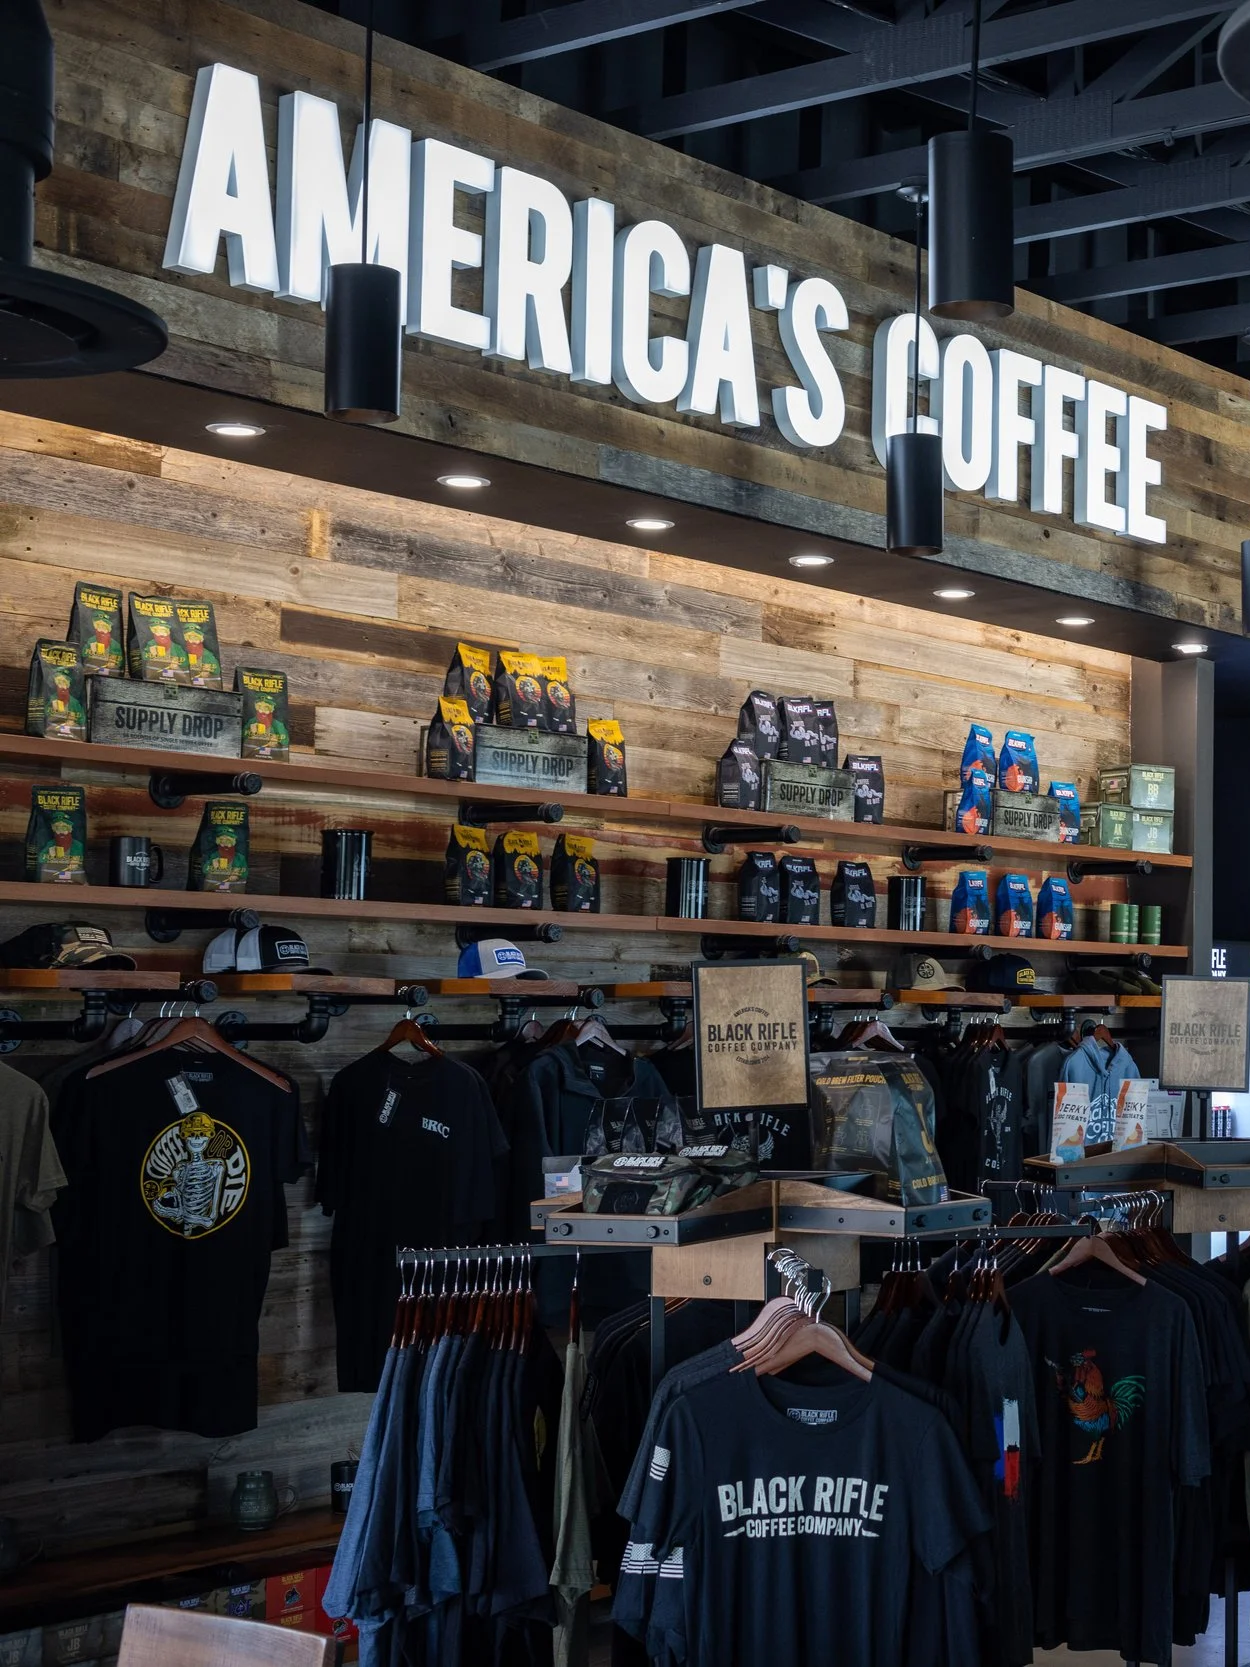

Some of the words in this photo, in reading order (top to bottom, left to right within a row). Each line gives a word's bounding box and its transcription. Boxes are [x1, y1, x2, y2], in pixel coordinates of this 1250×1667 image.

[162, 62, 849, 448] AMERICA'S
[873, 312, 1167, 545] COFFEE
[242, 676, 264, 688] BLACK
[264, 678, 284, 689] RIFLE
[115, 706, 177, 734] SUPPLY
[182, 714, 224, 740] DROP
[492, 750, 539, 774] SUPPLY
[542, 756, 574, 777] DROP
[38, 795, 60, 806] BLACK
[60, 796, 80, 807] RIFLE
[780, 783, 817, 804] SUPPLY
[819, 788, 844, 807] DROP
[1004, 810, 1032, 827] SUPPLY
[1034, 814, 1053, 830] DROP
[1114, 823, 1122, 836] AK
[1147, 827, 1158, 839] JB
[707, 1023, 753, 1041] BLACK
[758, 1022, 797, 1041] RIFLE
[1170, 1022, 1206, 1037] BLACK
[1209, 1023, 1241, 1038] RIFLE
[707, 1042, 745, 1053] COFFEE
[750, 1041, 797, 1051] COMPANY
[1169, 1037, 1199, 1045] COFFEE
[1203, 1037, 1241, 1047] COMPANY
[816, 1077, 831, 1085] COLD
[831, 1076, 847, 1085] BREW
[847, 1074, 865, 1083] FILTER
[1060, 1103, 1090, 1114] JERKY
[421, 1117, 450, 1139] BRCC
[146, 1127, 190, 1179] COFFEE
[208, 1131, 232, 1158] OR
[220, 1145, 246, 1216] DIE
[717, 1475, 807, 1522] BLACK
[814, 1475, 889, 1522] RIFLE
[745, 1516, 796, 1538] COFFEE
[797, 1515, 863, 1538] COMPANY
[67, 1637, 80, 1650] JB
